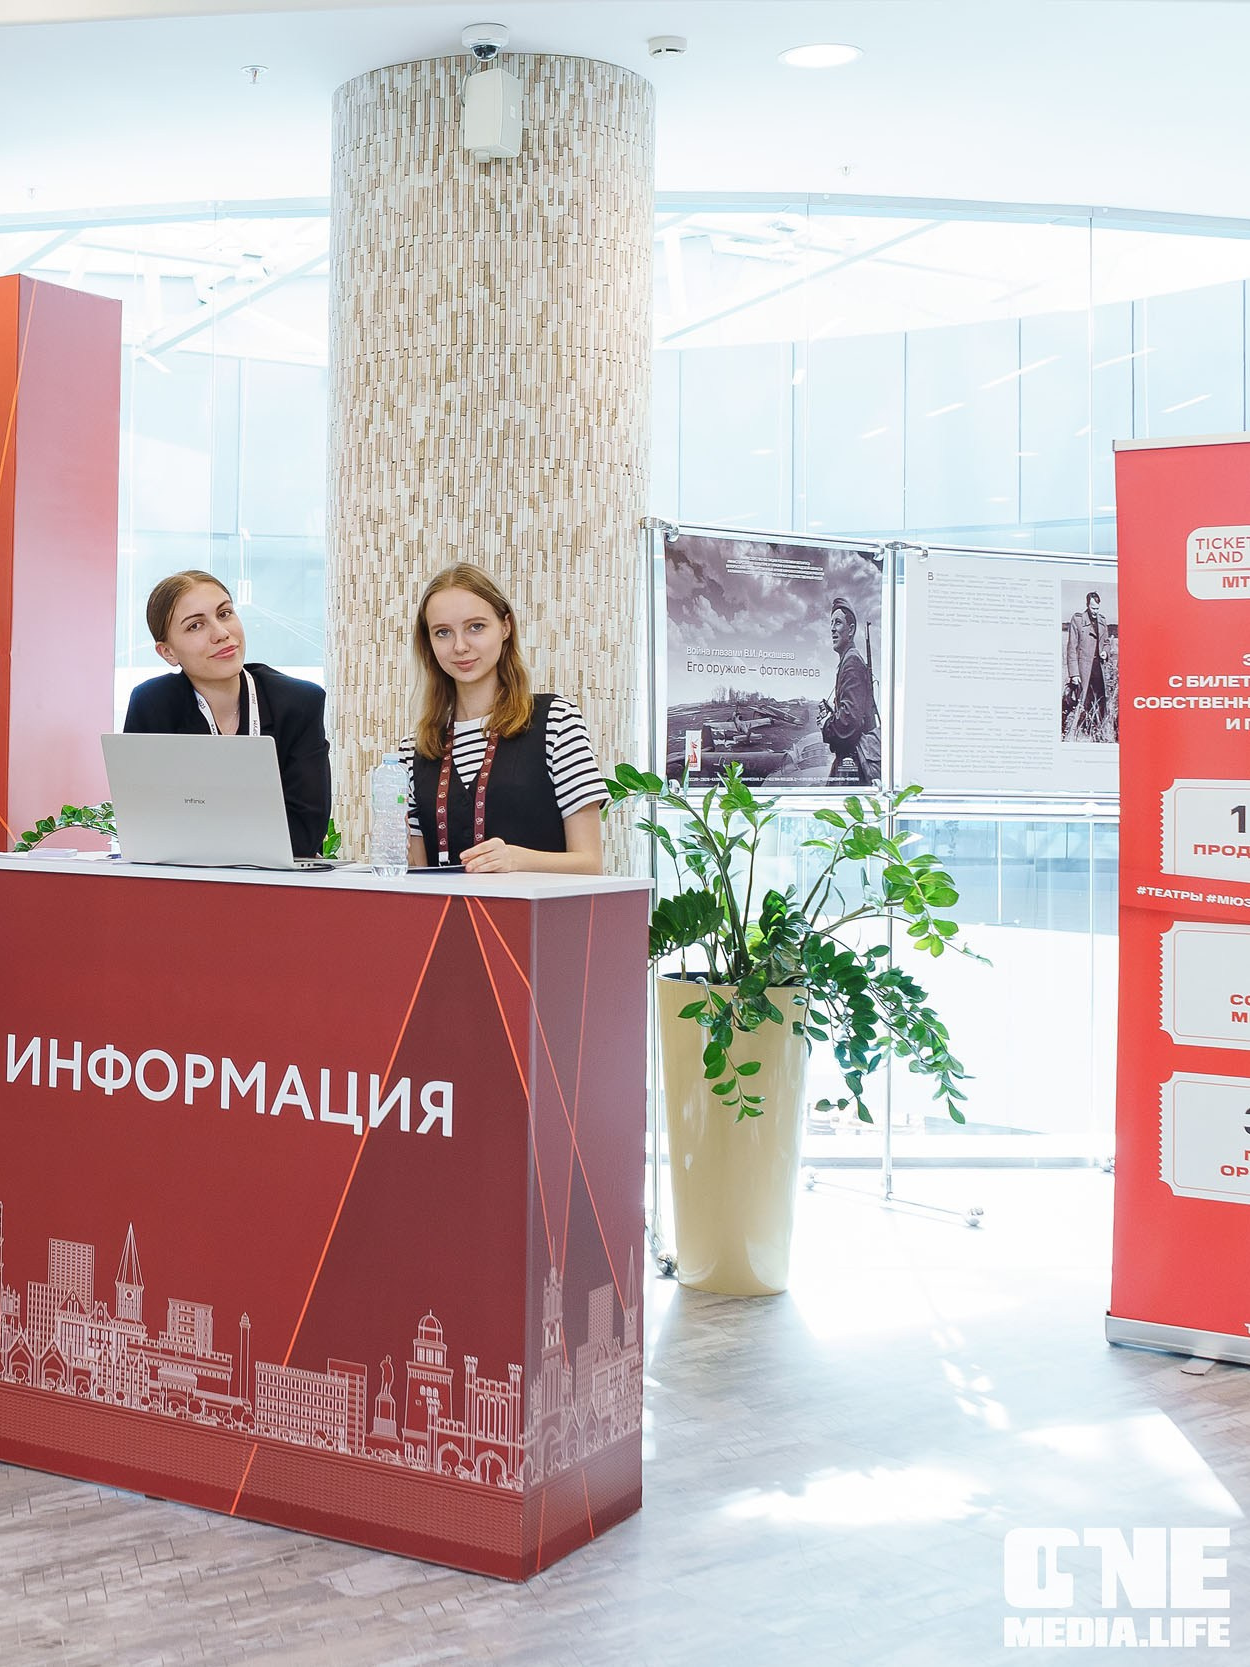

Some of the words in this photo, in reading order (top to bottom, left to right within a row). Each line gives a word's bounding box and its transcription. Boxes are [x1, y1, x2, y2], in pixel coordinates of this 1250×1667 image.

[1196, 551, 1243, 564] LAND
[687, 647, 711, 656] Война
[687, 661, 704, 673] Его
[706, 663, 746, 676] оружие
[759, 664, 821, 677] фотокамера
[1169, 676, 1183, 687] С
[1134, 696, 1250, 708] СОБСТВЕНН
[1226, 718, 1240, 730] И
[1136, 885, 1203, 902] #ТЕАТРЫ
[6, 1033, 454, 1138] ИНФОРМАЦИЯ
